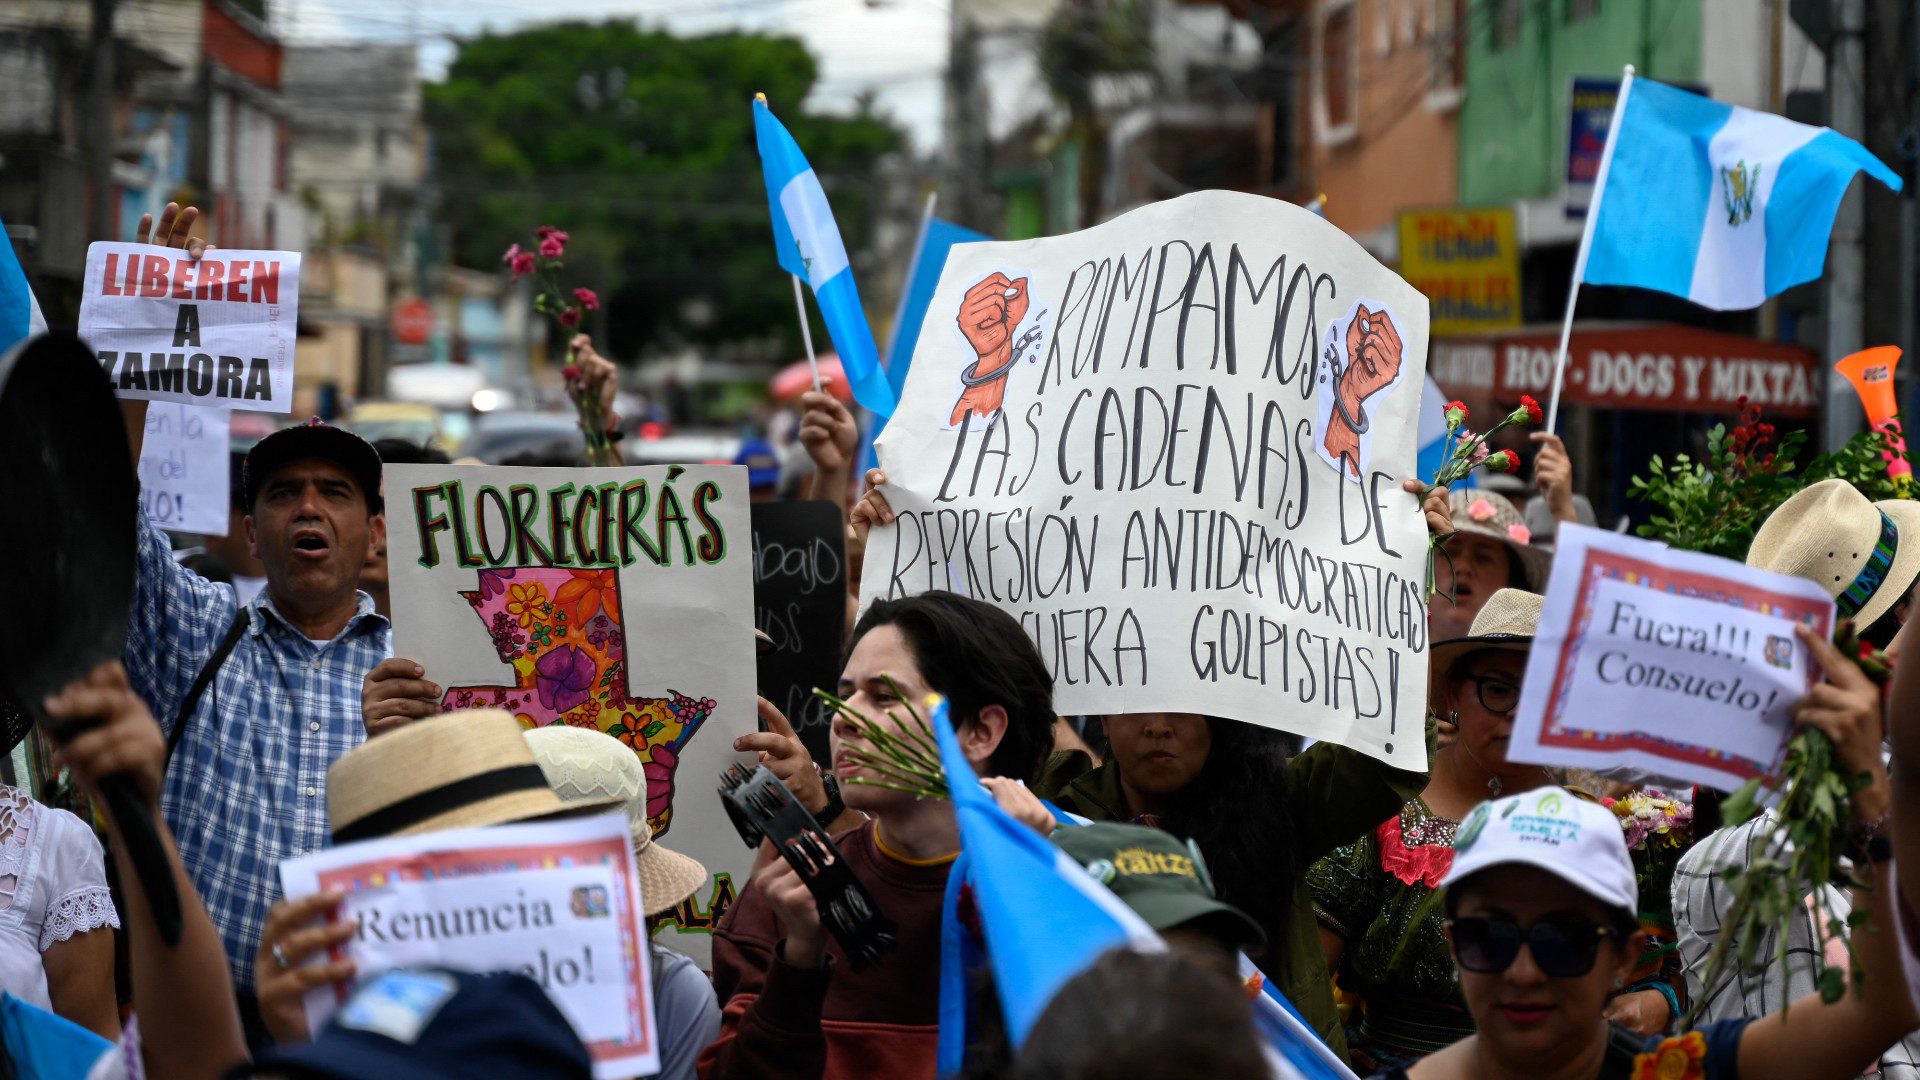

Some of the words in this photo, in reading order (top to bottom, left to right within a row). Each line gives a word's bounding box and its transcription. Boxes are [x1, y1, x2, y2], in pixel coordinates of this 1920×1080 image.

[101, 253, 281, 304] LIBEREN
[171, 303, 201, 347] A
[1037, 239, 1337, 400] ROMPAMOS
[98, 350, 273, 401] ZAMORA
[1683, 357, 1703, 399] Y
[933, 400, 1043, 504] LAS
[1057, 383, 1313, 531] CADENAS
[1338, 449, 1403, 558] DE
[411, 465, 728, 569] FLORECERÁS
[887, 495, 1099, 604] REPRESIÓN
[1121, 506, 1427, 653] ANTIDEMOCRATICAS
[1606, 600, 1750, 663] Fuera!!!
[1190, 604, 1401, 754] GOLPISTAS!
[1597, 651, 1778, 716] Consuelo!
[357, 889, 556, 942] Renuncia
